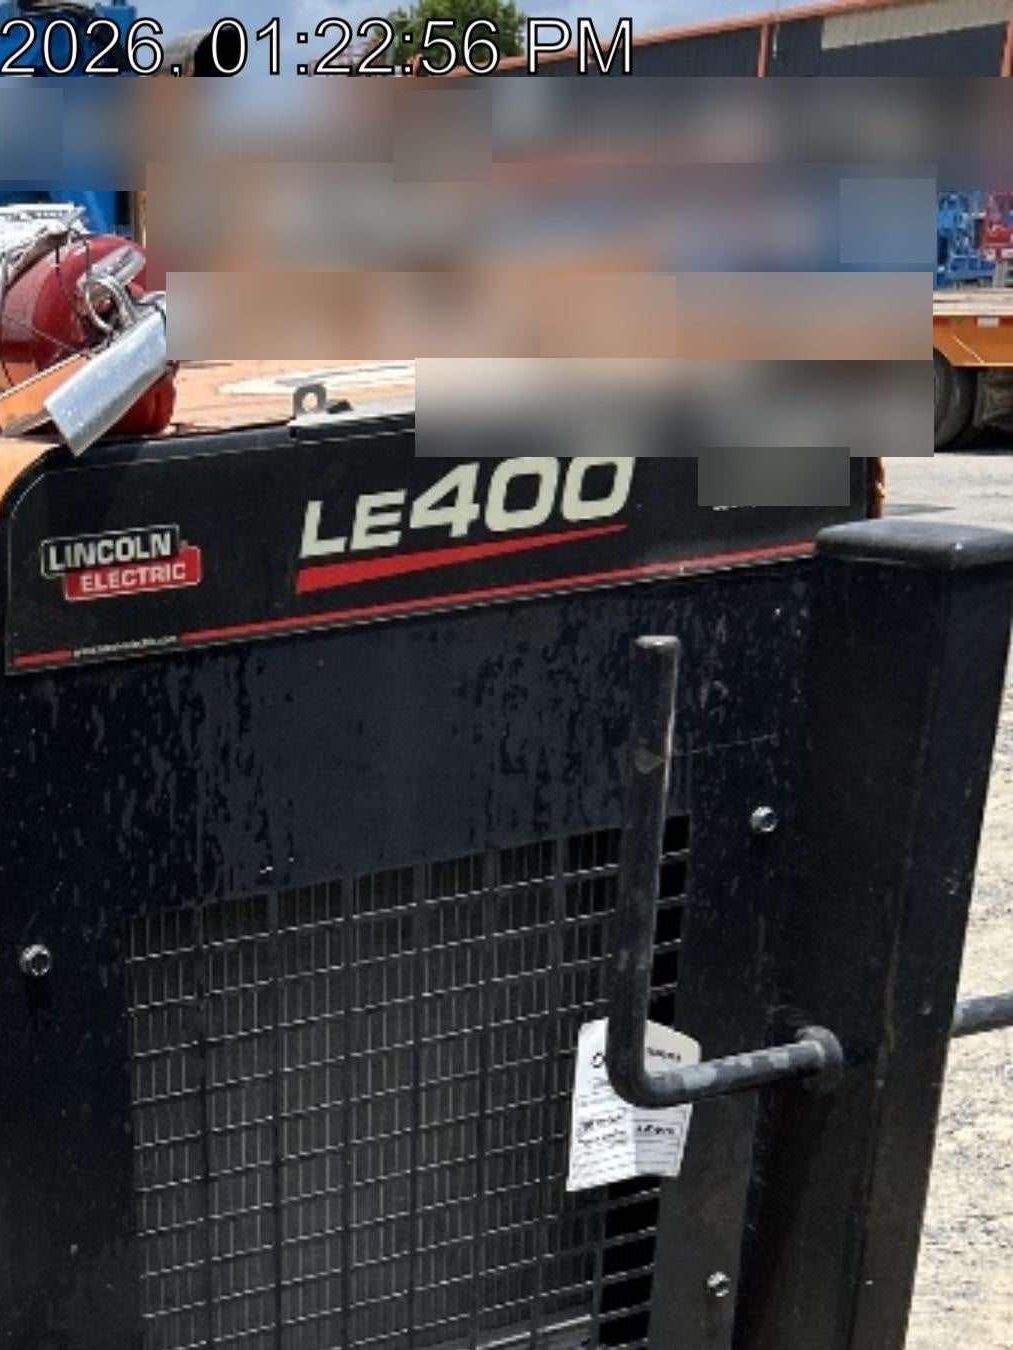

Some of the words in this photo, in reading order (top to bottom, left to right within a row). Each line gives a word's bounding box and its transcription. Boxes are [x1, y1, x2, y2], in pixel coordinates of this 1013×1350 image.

[299, 457, 636, 558] LE400
[48, 531, 172, 571] LINCOLN
[80, 562, 187, 593] ELECTRIC
